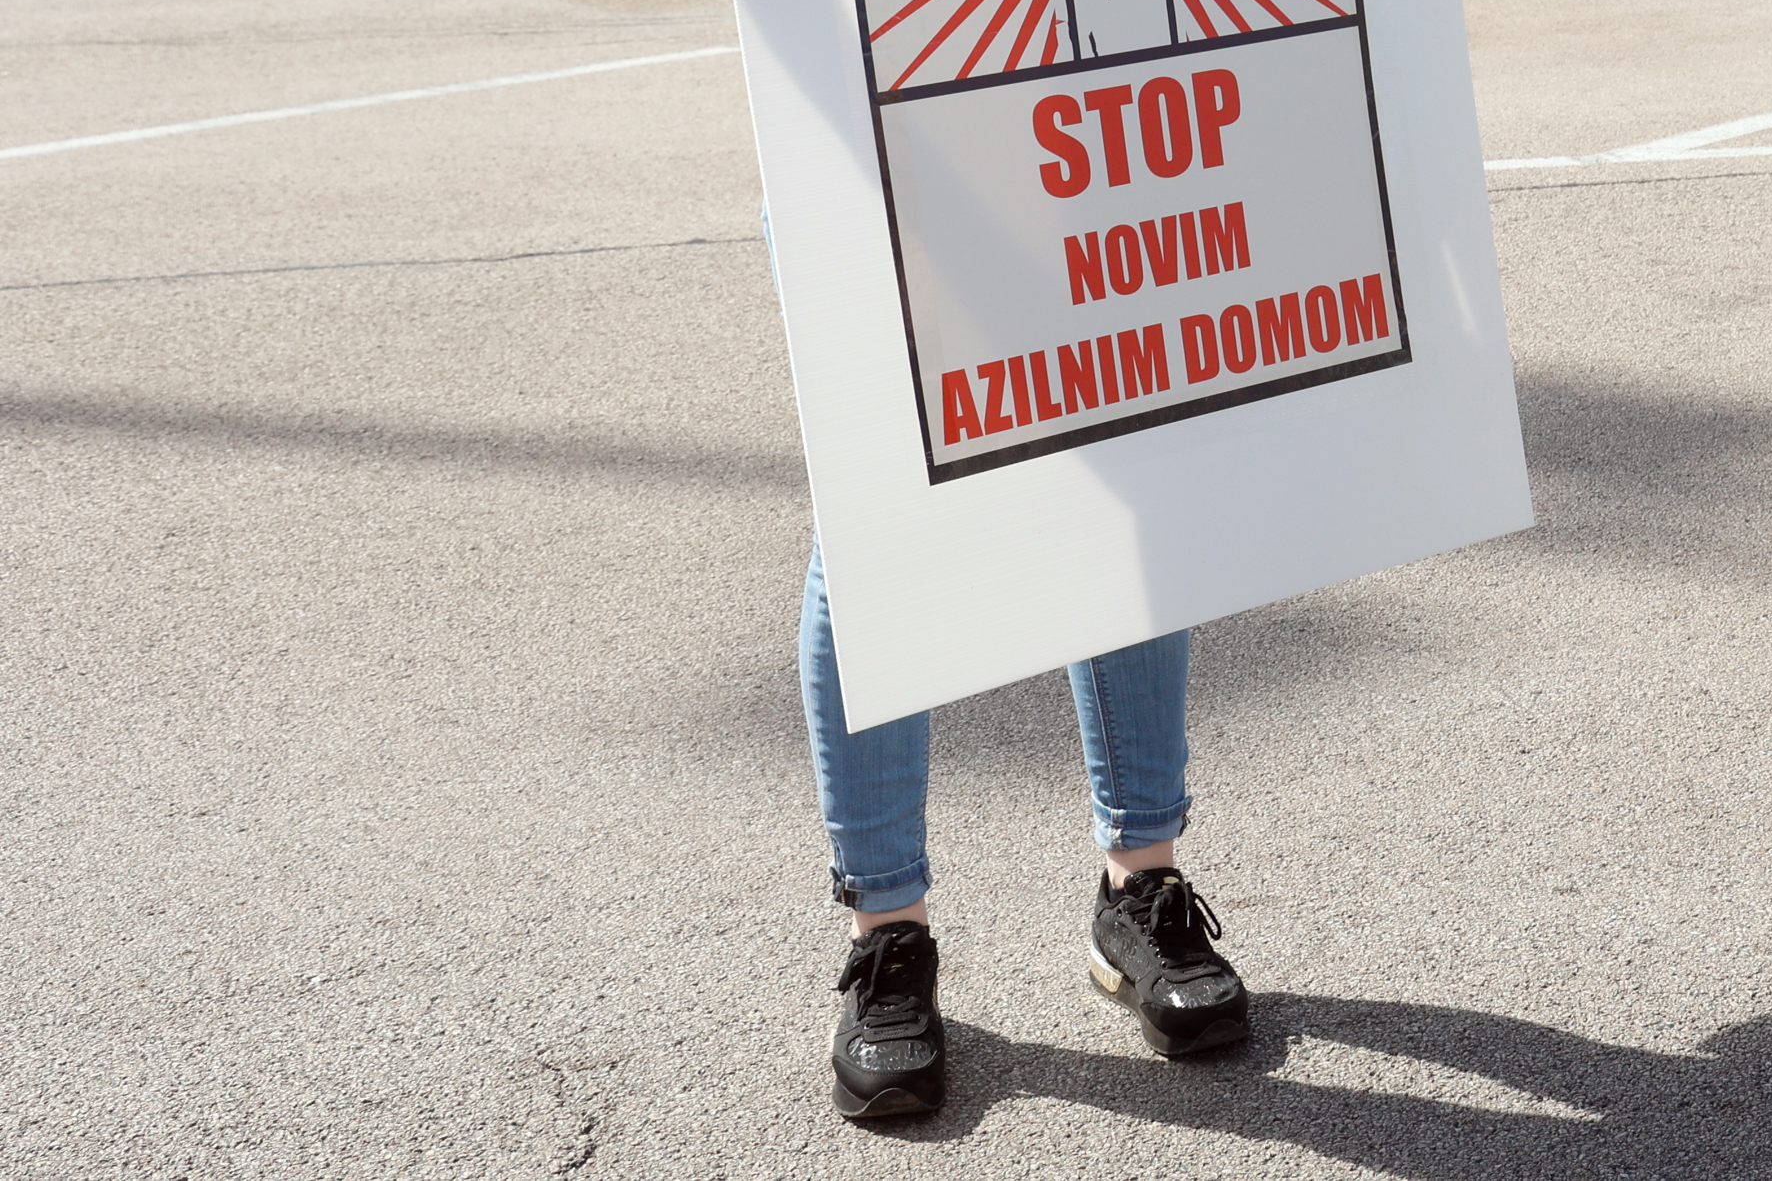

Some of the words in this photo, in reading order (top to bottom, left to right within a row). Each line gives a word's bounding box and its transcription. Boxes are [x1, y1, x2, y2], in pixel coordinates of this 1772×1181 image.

[1033, 69, 1241, 199] STOP
[1064, 201, 1251, 306] NOVIM
[942, 323, 1170, 446] AZILNIM
[1180, 273, 1389, 385] DOMOM
